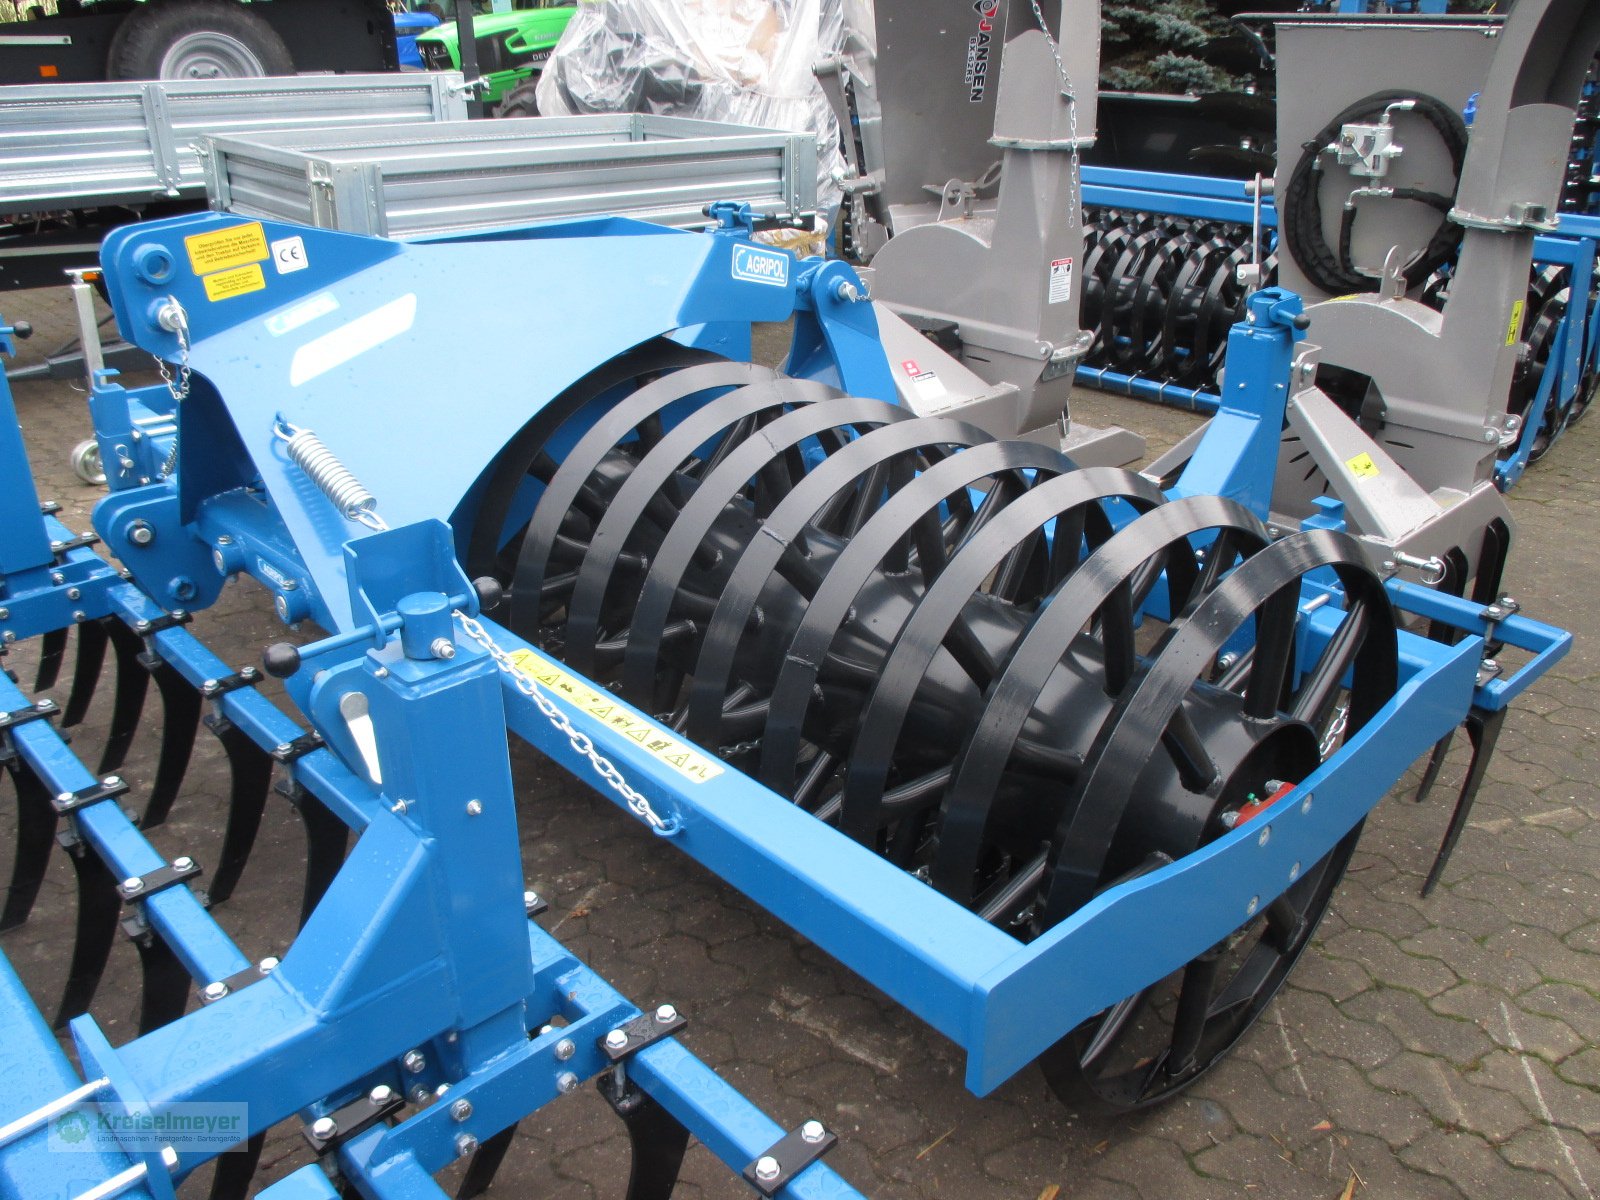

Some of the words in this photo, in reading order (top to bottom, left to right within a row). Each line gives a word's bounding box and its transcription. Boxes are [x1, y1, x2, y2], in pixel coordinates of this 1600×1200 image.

[532, 51, 551, 61] DEU
[966, 38, 977, 82] BX-62RS
[970, 19, 992, 102] JANSEN
[746, 254, 784, 278] AGRIPOL
